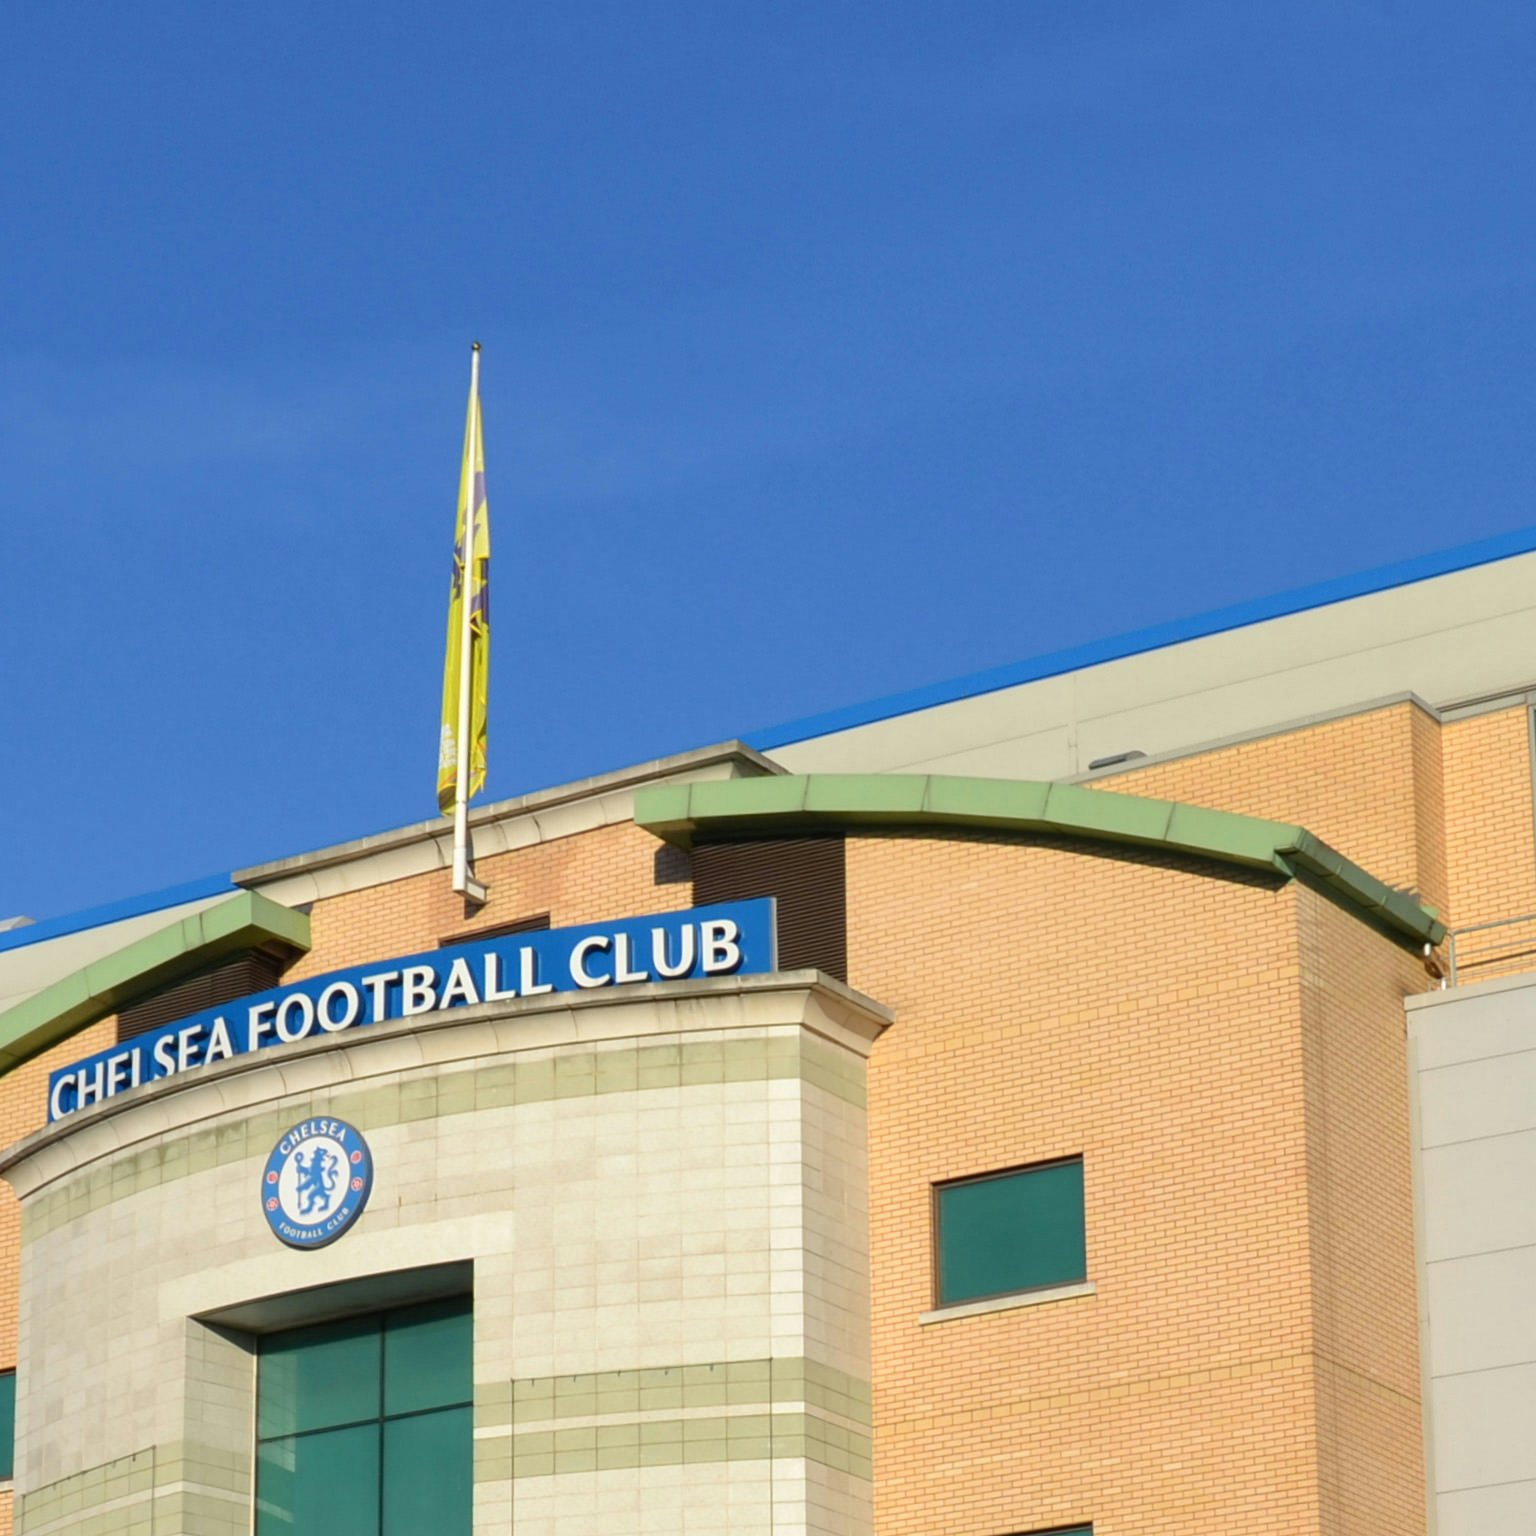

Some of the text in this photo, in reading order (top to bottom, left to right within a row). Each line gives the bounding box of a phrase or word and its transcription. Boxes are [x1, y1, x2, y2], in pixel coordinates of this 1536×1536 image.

[51, 919, 741, 1121] CHELSEA FOOTBALL CLUB
[280, 1120, 346, 1155] CHELSEA
[278, 1207, 350, 1239] FOOTBALL CLUB
